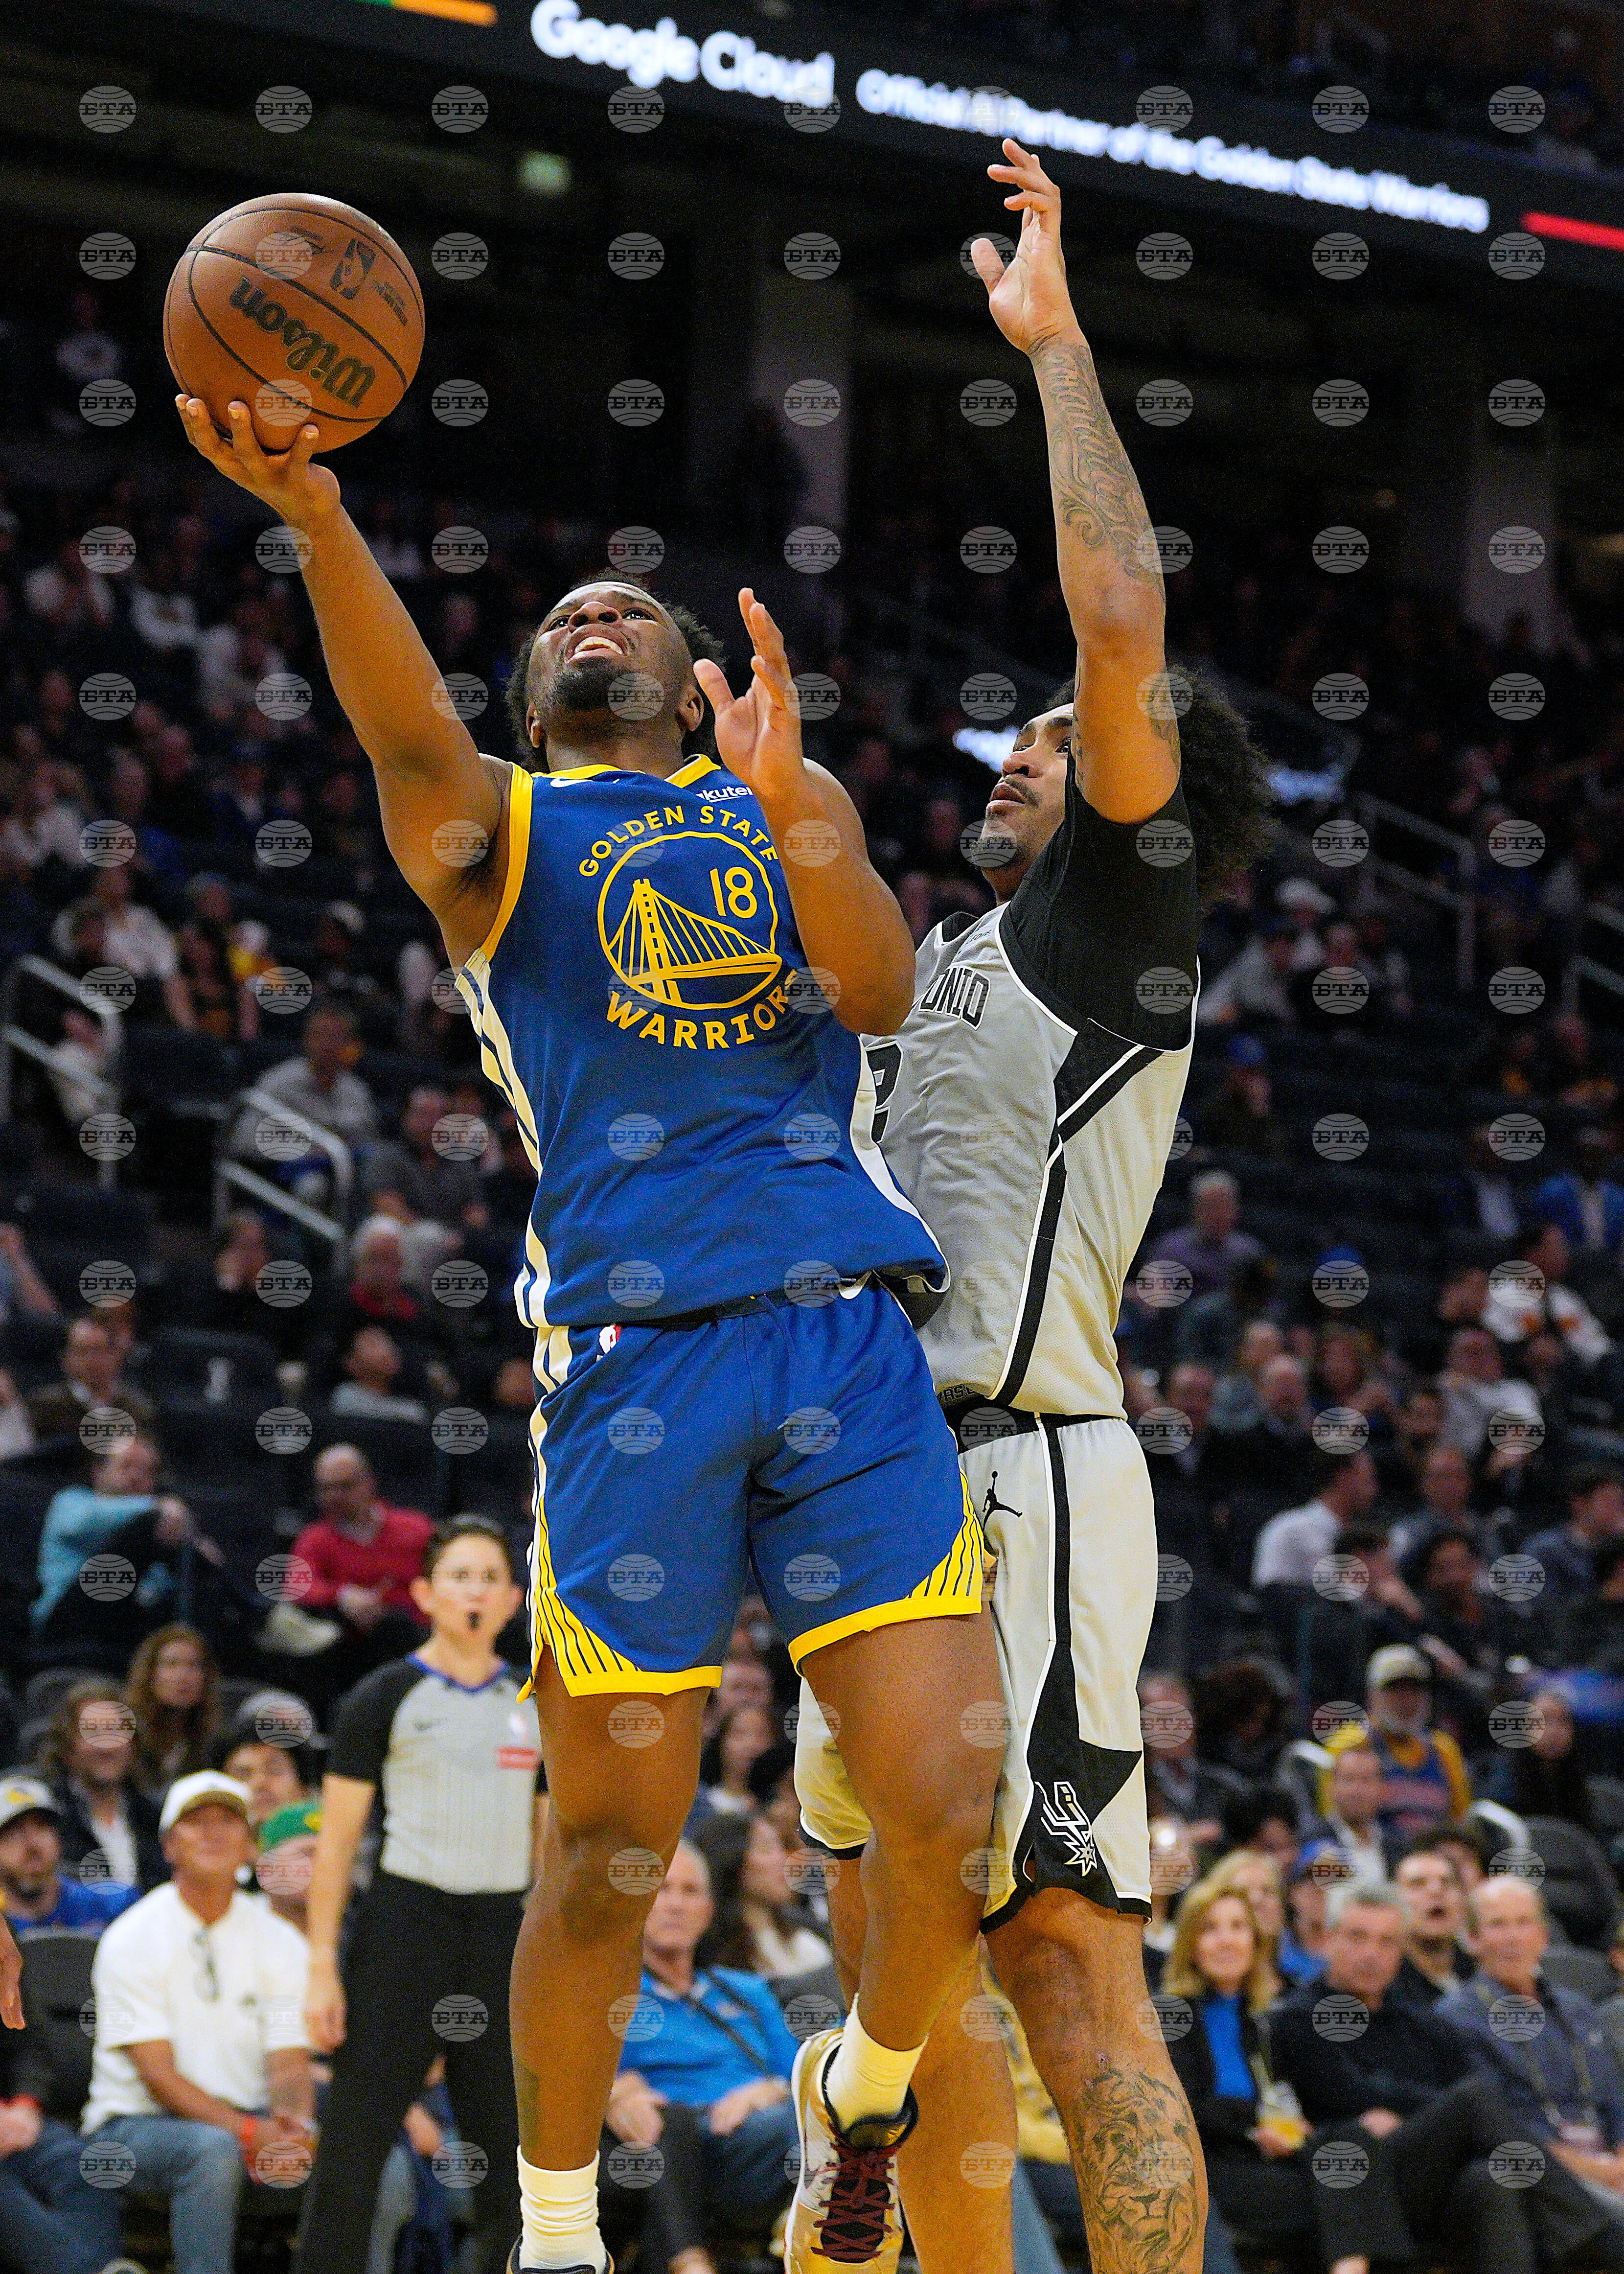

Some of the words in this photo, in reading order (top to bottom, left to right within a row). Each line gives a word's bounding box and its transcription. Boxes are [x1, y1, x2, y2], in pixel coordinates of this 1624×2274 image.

[530, 0, 701, 89] Google
[230, 276, 375, 408] Wilson
[579, 805, 685, 877] GOLDEN
[700, 806, 778, 861] STATE
[709, 866, 757, 918] 18
